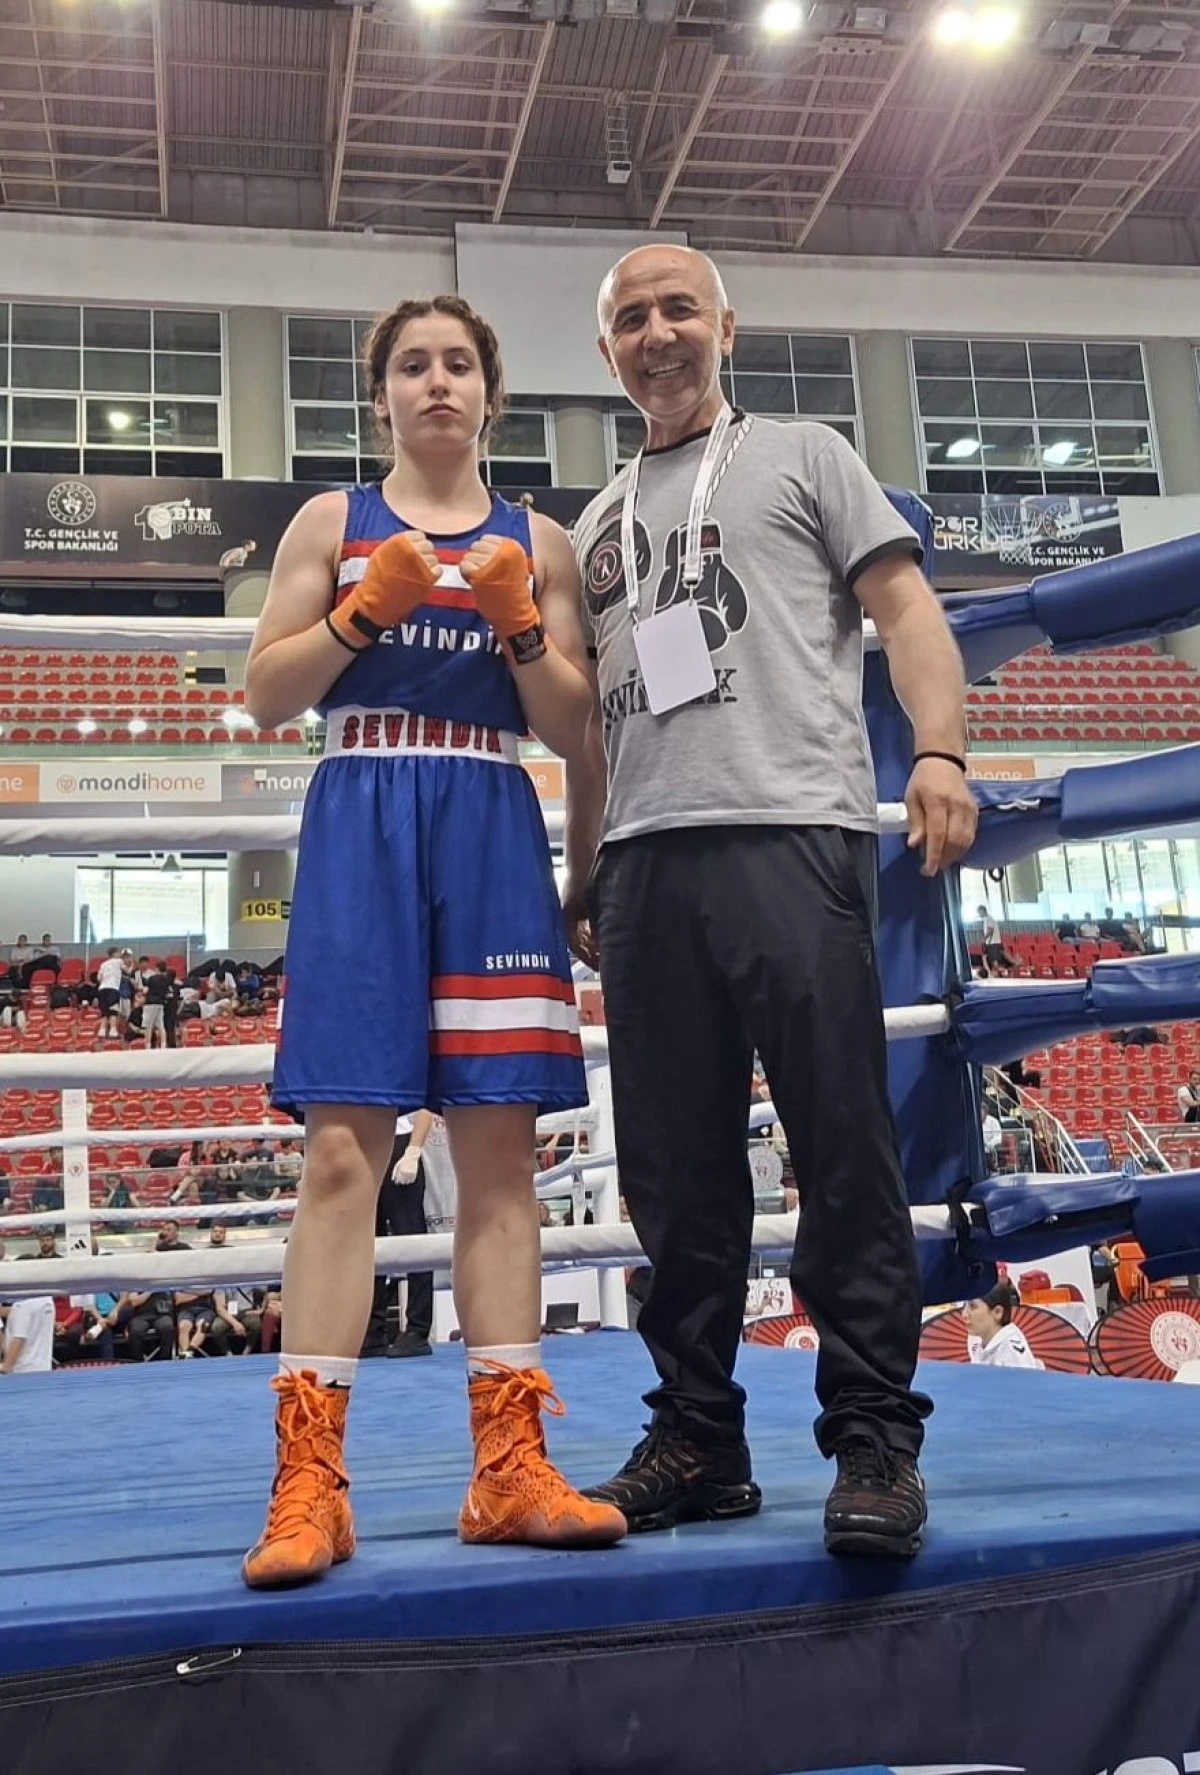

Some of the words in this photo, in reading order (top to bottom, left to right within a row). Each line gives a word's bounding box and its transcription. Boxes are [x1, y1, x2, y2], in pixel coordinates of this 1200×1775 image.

[24, 527, 46, 539] T.C.
[48, 528, 101, 541] GENÇLİK
[103, 530, 118, 540] VE
[24, 540, 55, 550] SPOR
[57, 540, 118, 552] BAKANLIĞI
[79, 773, 206, 792] mondihome
[245, 902, 277, 918] 105
